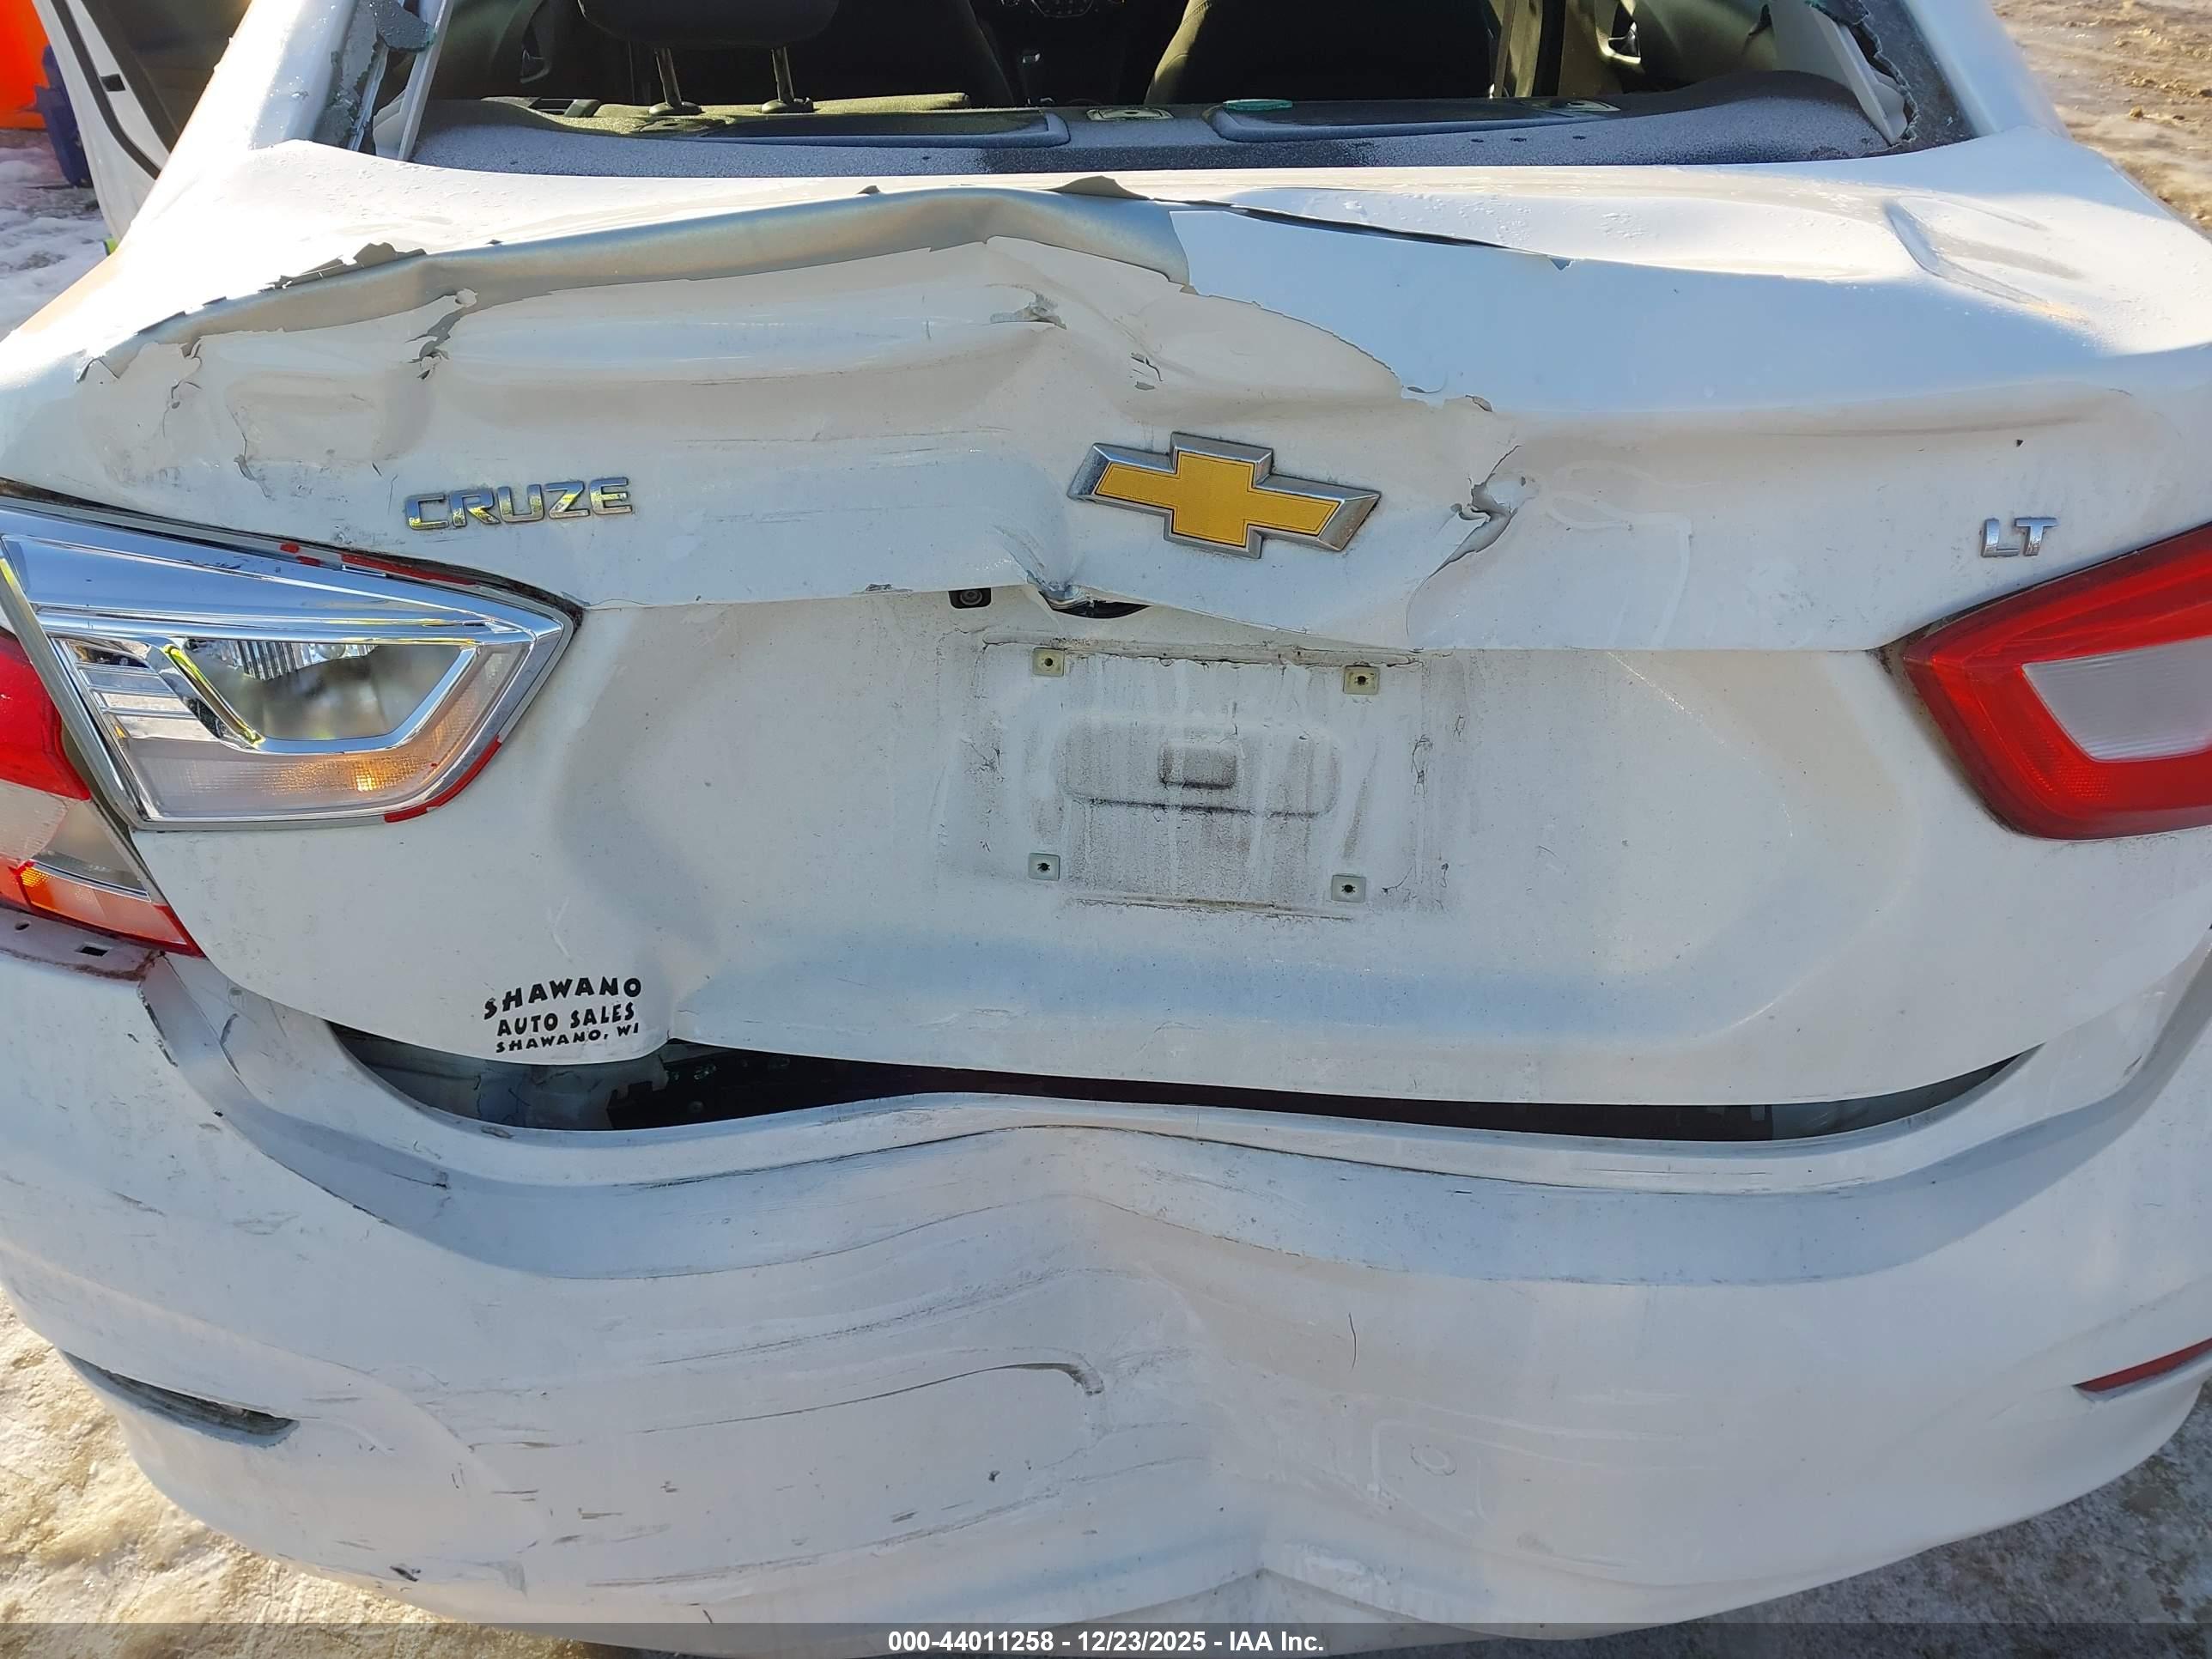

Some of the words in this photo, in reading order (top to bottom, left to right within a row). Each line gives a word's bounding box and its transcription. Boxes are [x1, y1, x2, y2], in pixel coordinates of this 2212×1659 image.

[404, 477, 633, 531] CRUZE
[1980, 516, 2058, 558] LT
[483, 975, 642, 1020] SHAWANO
[495, 1029, 610, 1054] SHAWANO,
[617, 1022, 640, 1037] WI
[496, 1012, 559, 1037] AUTO
[569, 1001, 635, 1029] SALES
